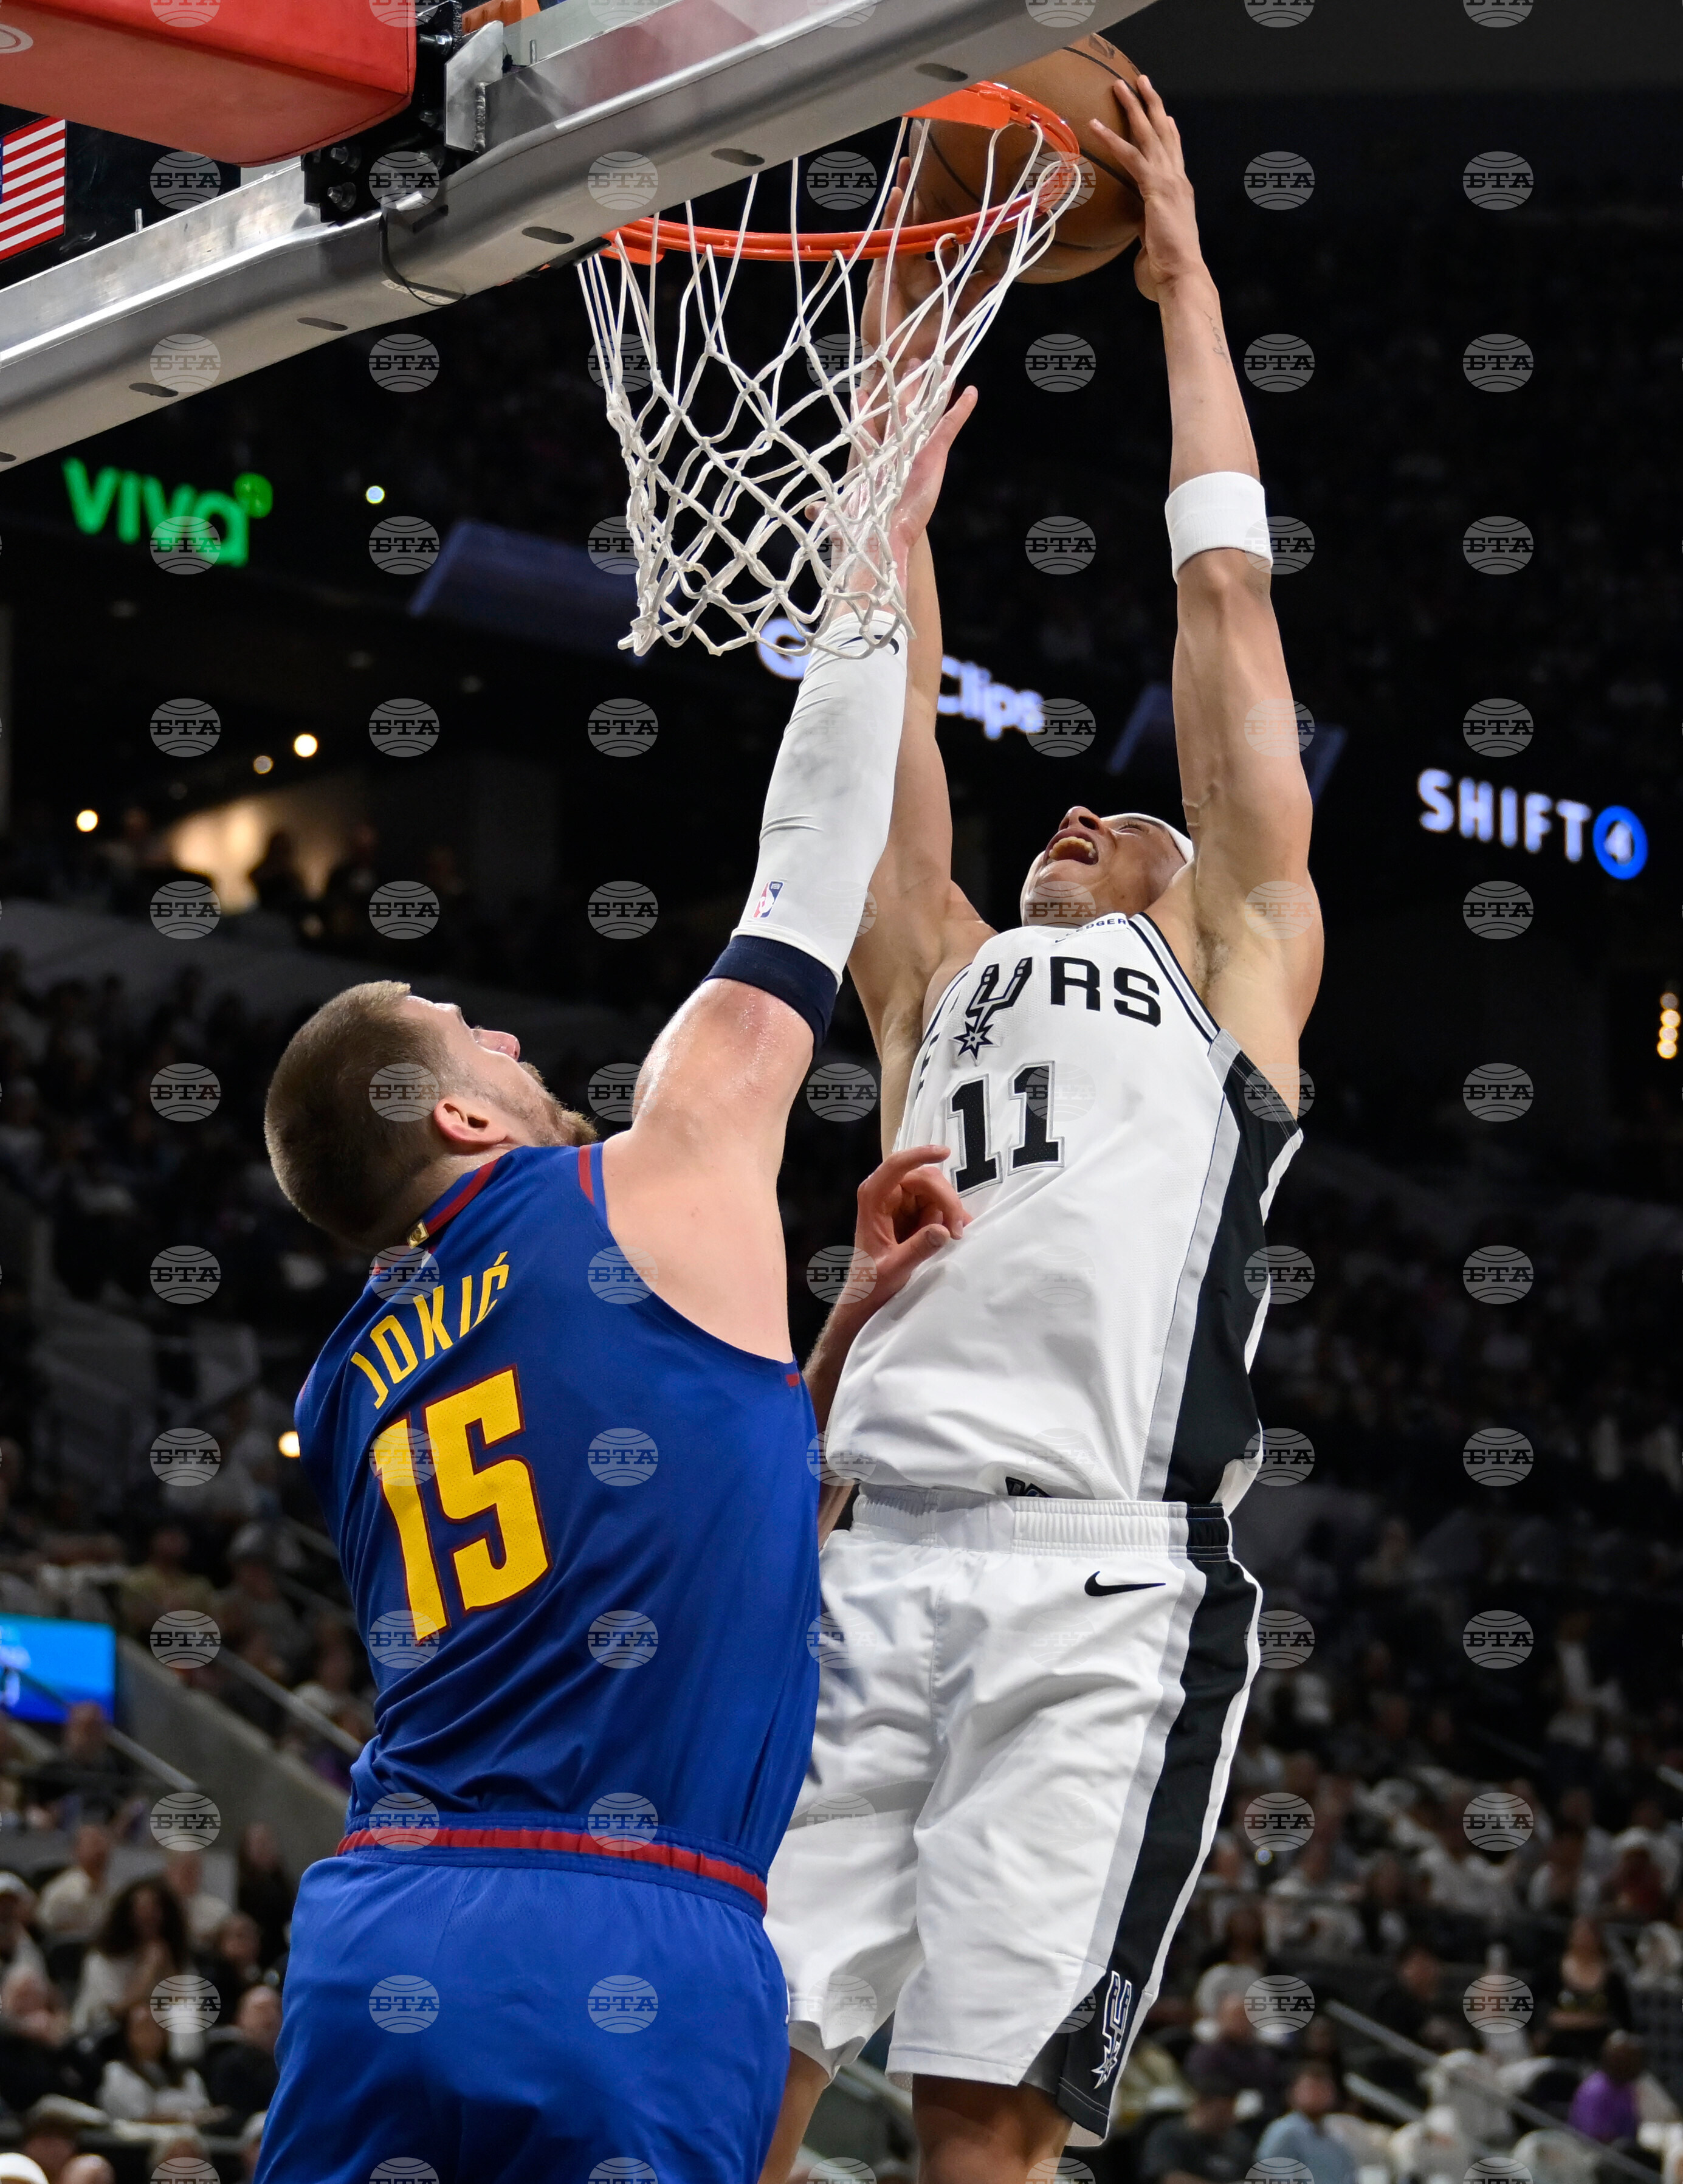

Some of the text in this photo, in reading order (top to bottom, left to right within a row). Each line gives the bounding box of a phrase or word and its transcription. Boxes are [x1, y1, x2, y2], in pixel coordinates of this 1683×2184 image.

[946, 1060, 1065, 1198] 11
[350, 1251, 509, 1410] JOKIĆ
[371, 1363, 554, 1647] 15
